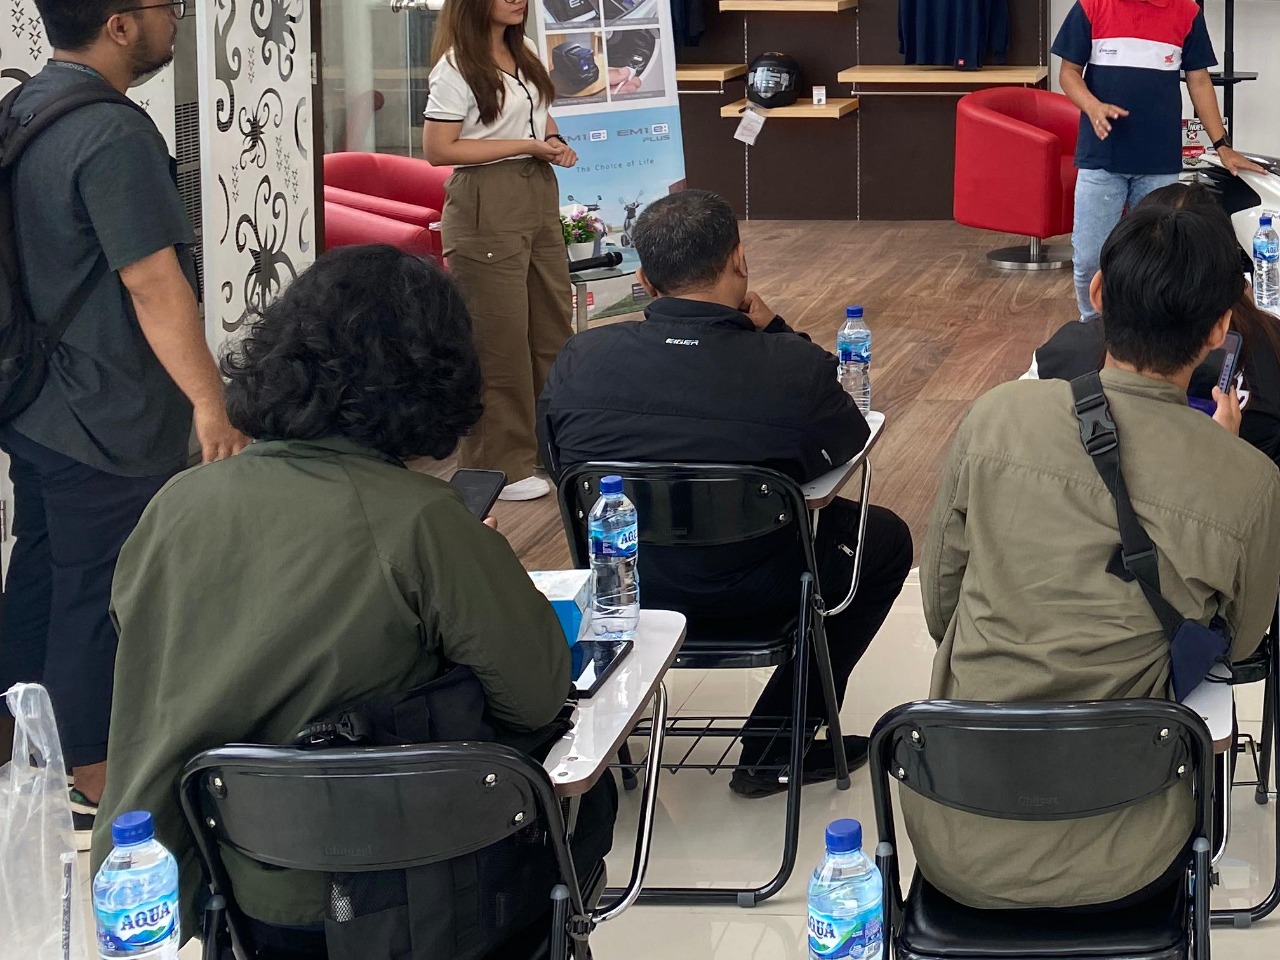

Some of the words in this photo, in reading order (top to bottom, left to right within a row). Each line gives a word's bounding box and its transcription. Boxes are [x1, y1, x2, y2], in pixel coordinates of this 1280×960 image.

[617, 127, 649, 137] EM1
[642, 135, 670, 143] PLUS
[595, 163, 622, 171] Choice
[639, 158, 655, 166] Life
[665, 338, 699, 346] EIGER
[120, 901, 171, 932] AQUA
